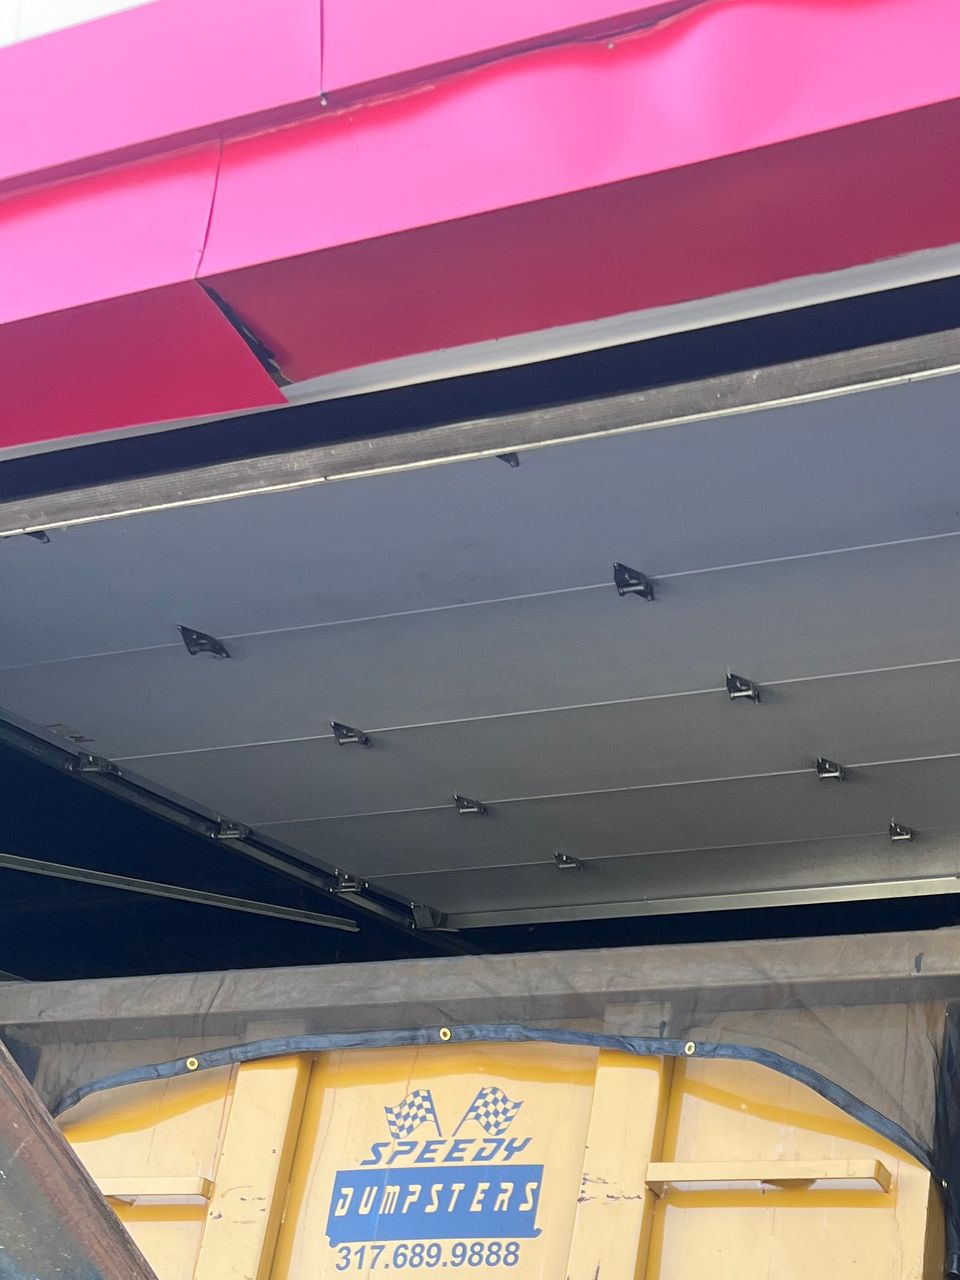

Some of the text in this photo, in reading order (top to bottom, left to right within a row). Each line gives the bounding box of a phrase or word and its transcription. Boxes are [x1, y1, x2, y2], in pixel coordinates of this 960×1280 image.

[360, 1137, 533, 1166] SPEEDY
[334, 1182, 538, 1217] DUMPSTERS
[335, 1241, 521, 1271] 317.689.9888
